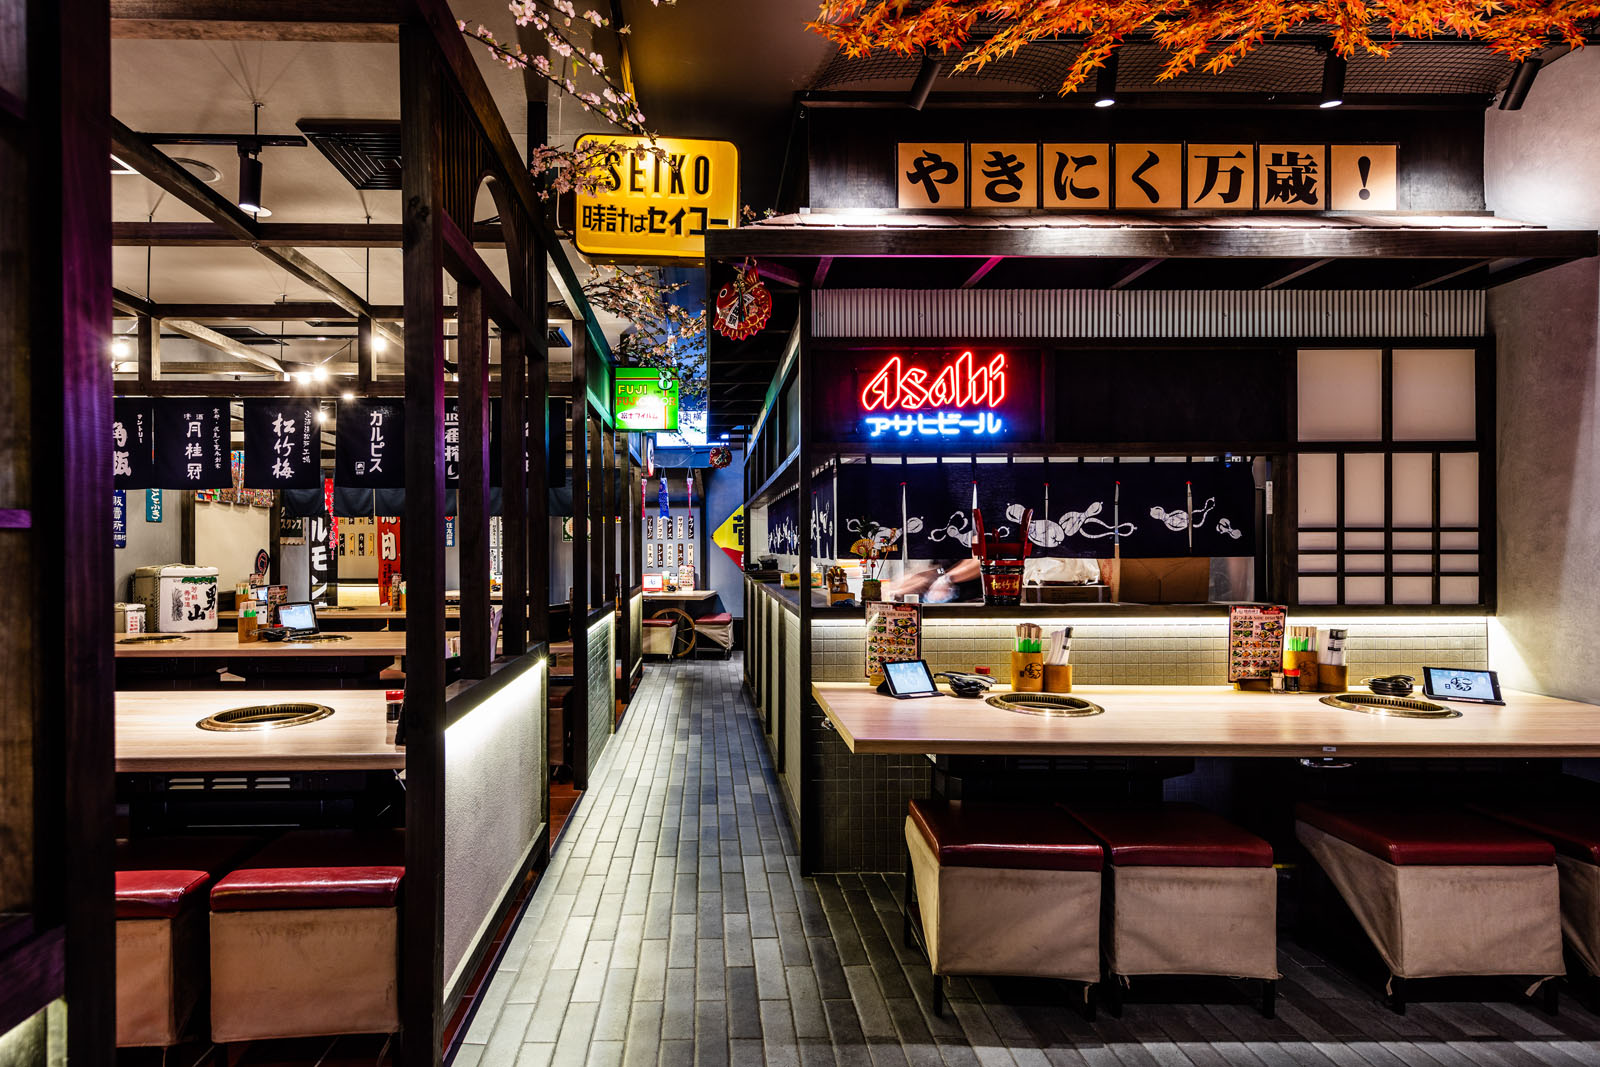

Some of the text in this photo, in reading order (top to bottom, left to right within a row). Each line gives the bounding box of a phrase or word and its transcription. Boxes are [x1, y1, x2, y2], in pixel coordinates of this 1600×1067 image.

[605, 152, 709, 195] SEIKO
[906, 149, 1370, 204] やきにく万歳!
[583, 204, 728, 236] 時計はセイコー
[616, 396, 676, 407] FUJOR
[618, 385, 648, 394] FUJI
[862, 351, 1005, 410] Asahi
[272, 413, 296, 479] 松竹梅
[369, 410, 385, 473] カルピス
[865, 411, 1002, 437] アサヒビール
[184, 421, 203, 480] 月桂冠
[311, 493, 328, 600] ルモン
[188, 584, 216, 622] 男山
